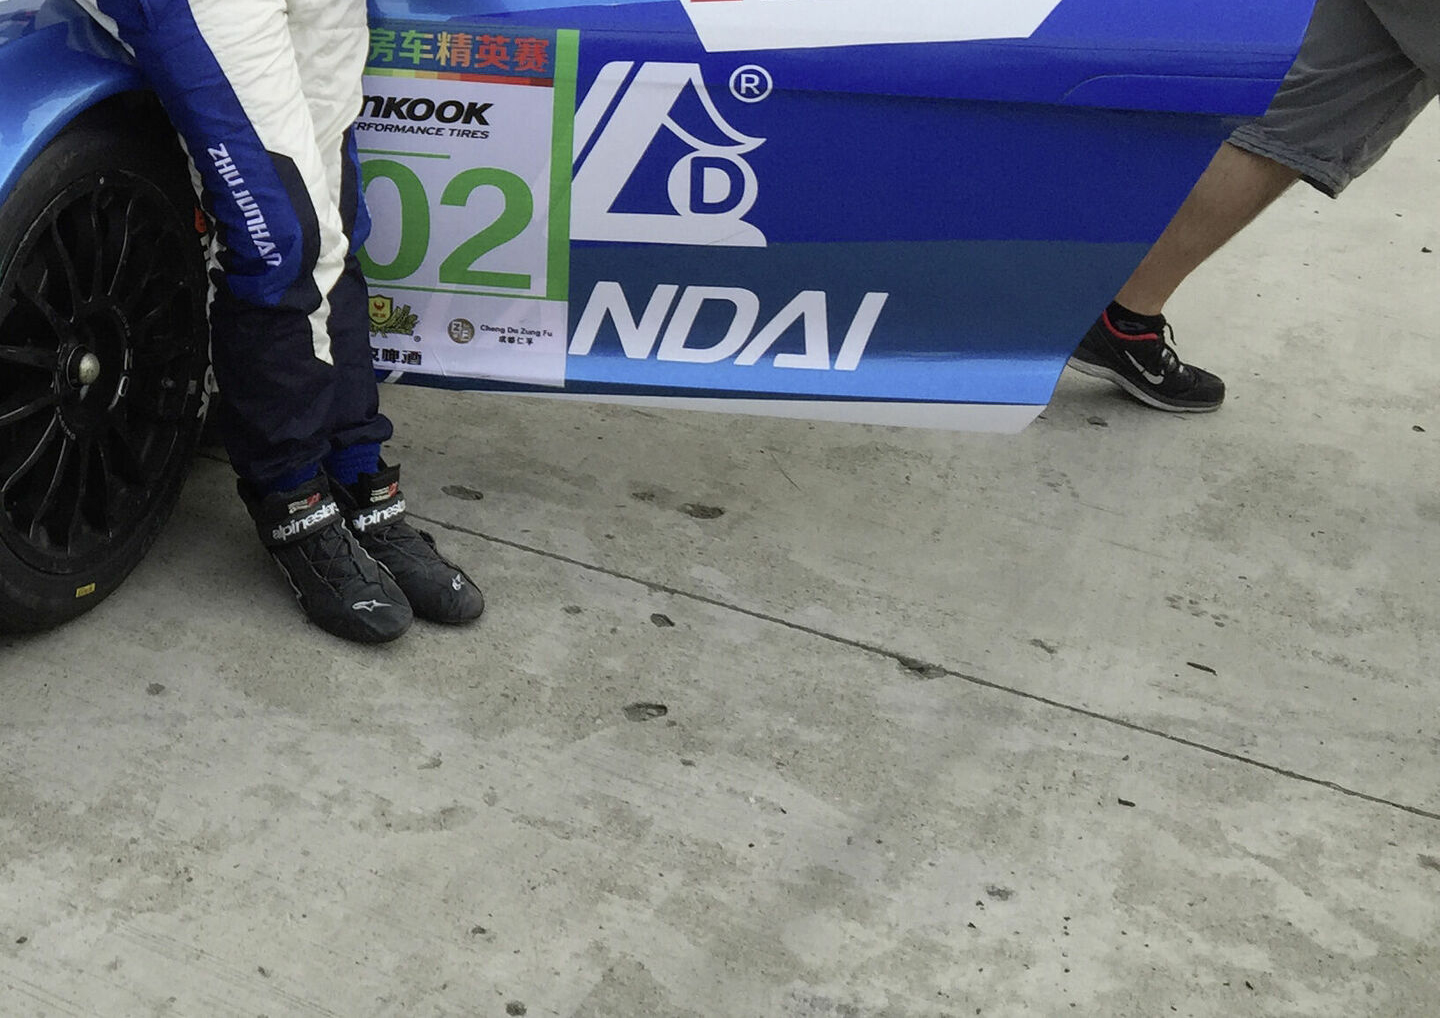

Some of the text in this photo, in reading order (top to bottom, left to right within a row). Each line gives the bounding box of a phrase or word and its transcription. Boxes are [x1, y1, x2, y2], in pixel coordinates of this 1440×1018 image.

[207, 142, 245, 188] ZHU
[448, 130, 490, 140] TIRES
[355, 159, 533, 289] 02
[568, 281, 890, 371] NDAI
